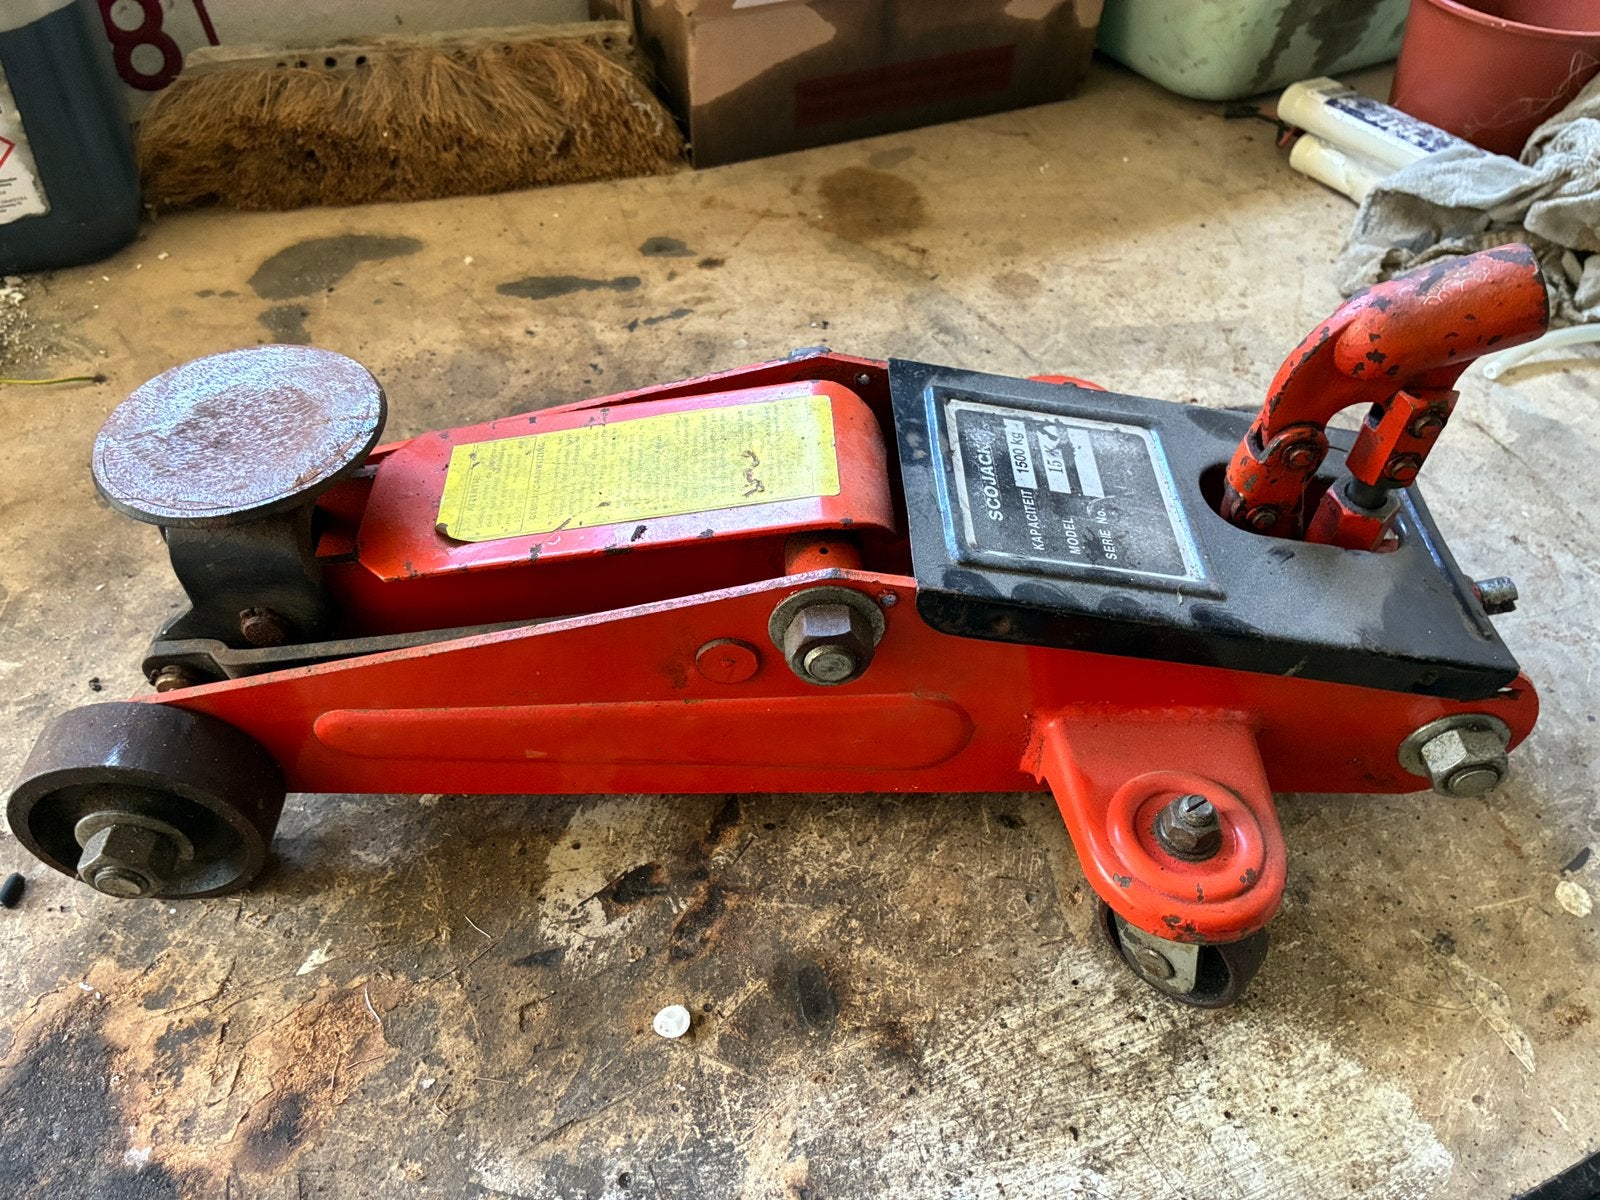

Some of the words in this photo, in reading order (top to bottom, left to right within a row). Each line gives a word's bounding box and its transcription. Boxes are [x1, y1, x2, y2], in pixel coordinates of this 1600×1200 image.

[1009, 431, 1025, 445] kg
[1011, 447, 1030, 474] 1500
[1045, 459, 1064, 473] 15
[975, 441, 1004, 521] SCOJACK
[1020, 488, 1046, 551] KAPACITEIT
[1061, 516, 1082, 555] MODEL
[1099, 529, 1119, 560] SERIE
